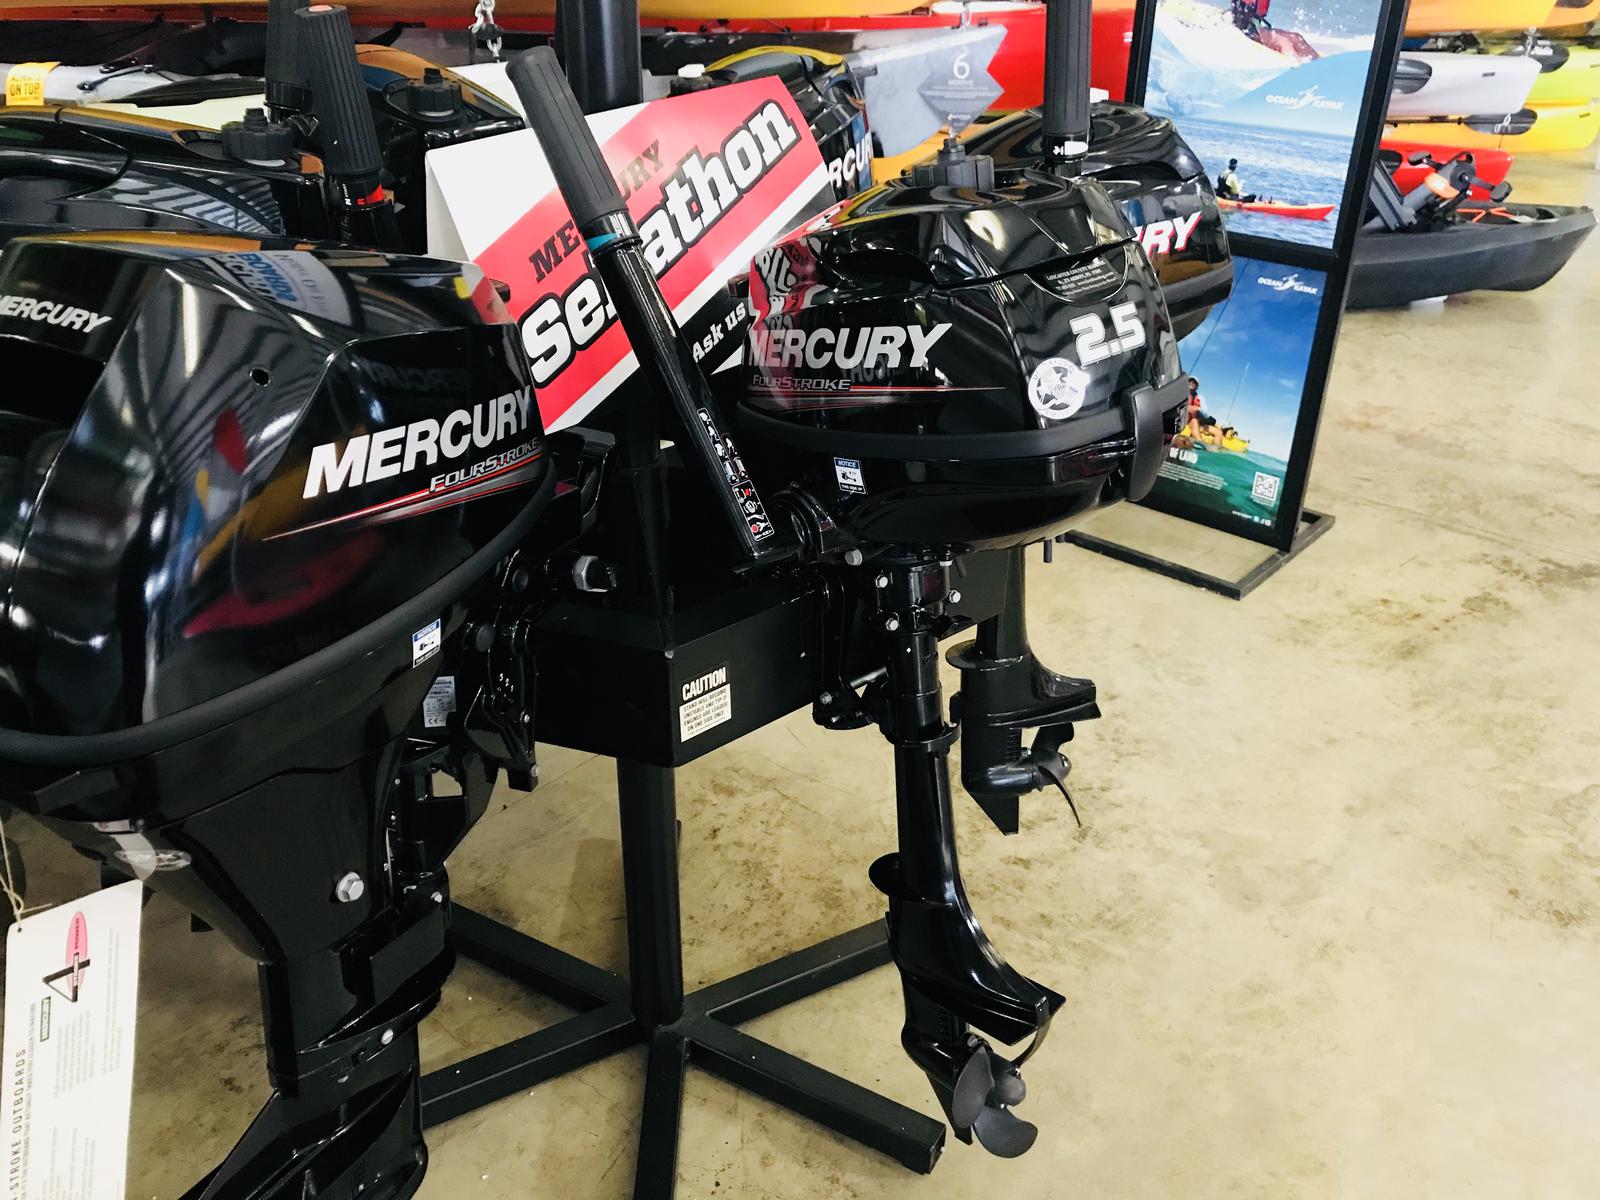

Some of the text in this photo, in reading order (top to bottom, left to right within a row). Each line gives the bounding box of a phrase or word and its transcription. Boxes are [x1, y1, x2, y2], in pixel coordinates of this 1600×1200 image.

[953, 47, 970, 79] 6
[10, 82, 40, 96] ON TOP
[1265, 94, 1298, 107] OCEAN
[1257, 277, 1318, 294] OCEAN KAYAK
[0, 295, 112, 333] ERCURY
[692, 302, 746, 363] Ask us
[1069, 301, 1146, 369] 2.5
[749, 323, 953, 369] MERCURY
[303, 385, 532, 499] MERCURY
[838, 460, 856, 468] NOTICE
[1179, 450, 1198, 464] LAND
[682, 667, 727, 701] CAUTION
[683, 701, 698, 712] STAND
[698, 696, 708, 705] WILL
[683, 705, 704, 718] UNSTABLE
[705, 701, 714, 709] AND
[684, 713, 702, 726] ENGINES
[687, 724, 694, 732] ON
[714, 710, 724, 719] ONLY
[12, 1049, 25, 1134] OUTBOARDS
